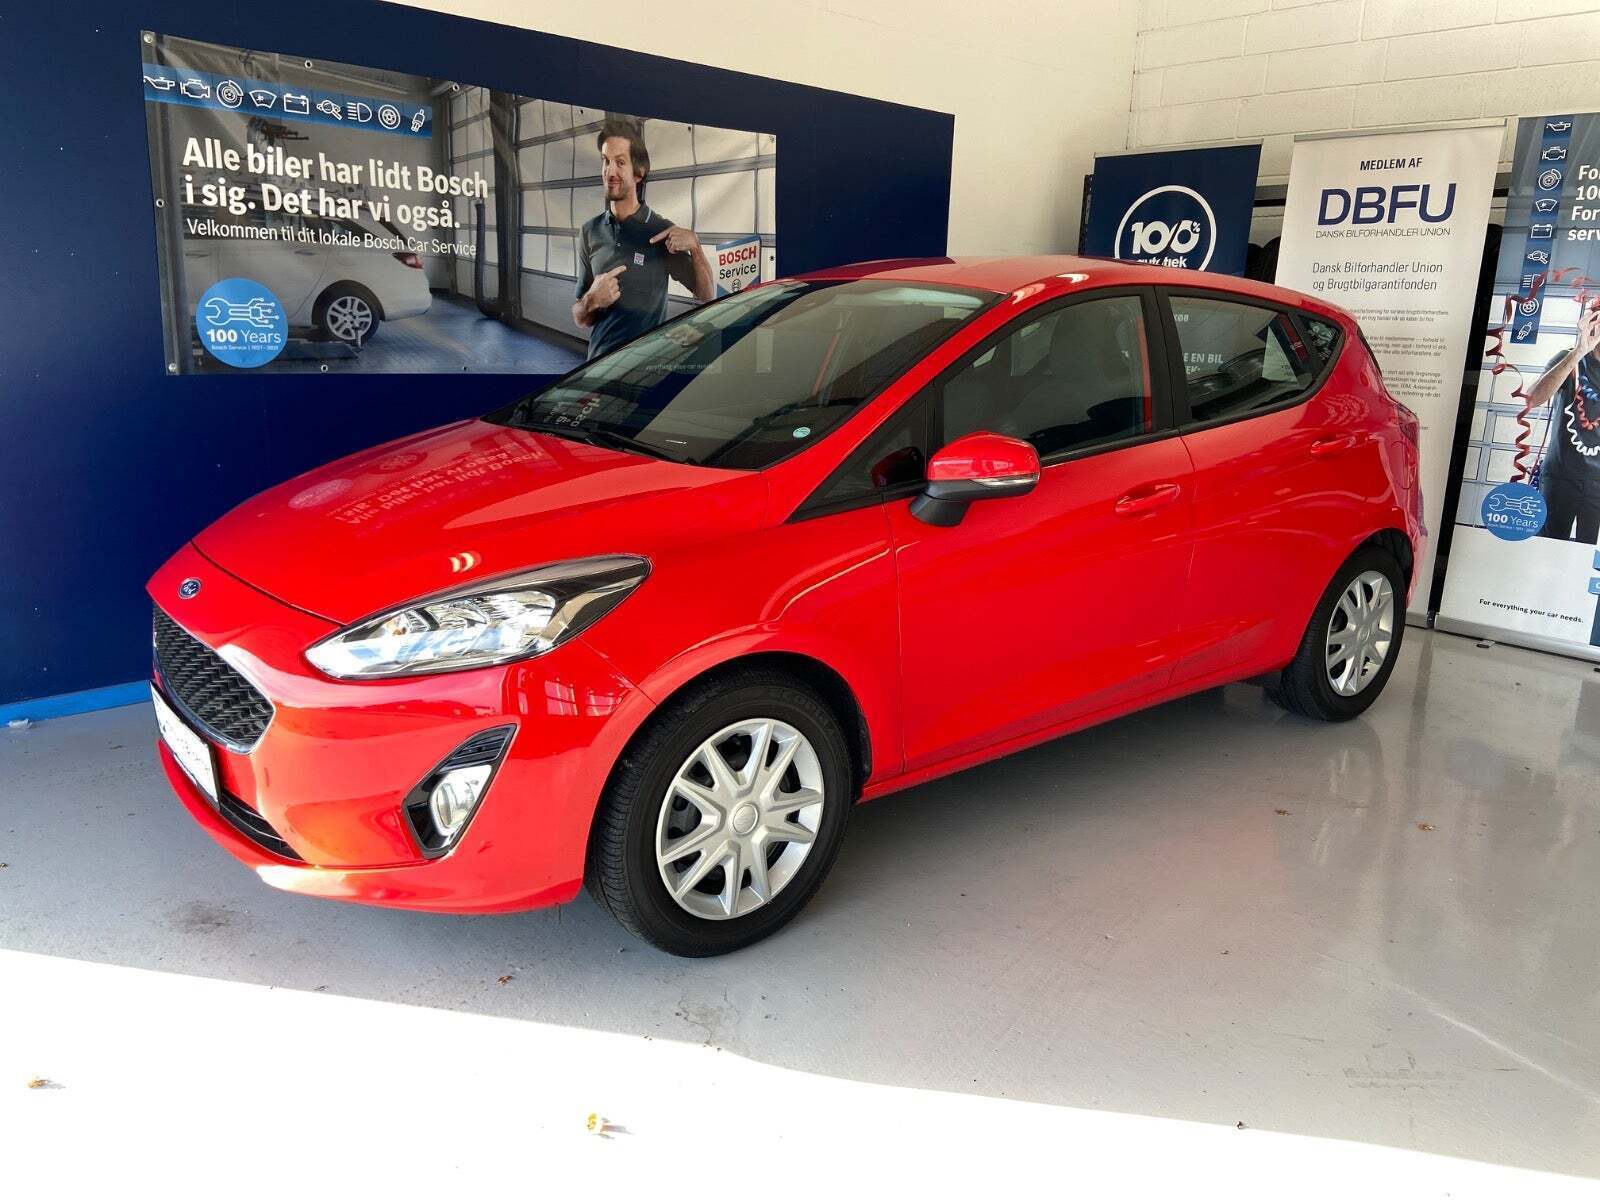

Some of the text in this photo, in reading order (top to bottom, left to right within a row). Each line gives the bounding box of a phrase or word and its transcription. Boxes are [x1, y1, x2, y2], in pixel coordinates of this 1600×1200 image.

[182, 137, 488, 198] Alle biler har lidt Bosch
[1360, 158, 1423, 171] MEDLEM AF
[1578, 164, 1600, 180] Fo
[1576, 185, 1600, 201] 10
[185, 174, 460, 232] i sig. Det har vi også.
[1318, 183, 1457, 226] DBFU
[187, 218, 476, 256] Velkommen til dit lokale Bosch Car Service
[1315, 227, 1451, 238] DANSK BILFORHANDLER UNION
[719, 246, 757, 266] BOSCH
[719, 264, 757, 279] Service
[1313, 262, 1443, 273] Dansk Bilforhandler Union
[1313, 278, 1437, 292] og Brugtbilgarantifonden
[206, 329, 281, 343] 100 Years
[1191, 353, 1205, 363] EN
[1208, 354, 1224, 364] BIL
[1487, 513, 1508, 523] 100
[1511, 516, 1538, 528] Years
[1479, 598, 1491, 606] For
[1492, 602, 1528, 614] everything
[1560, 614, 1584, 623] needs.
